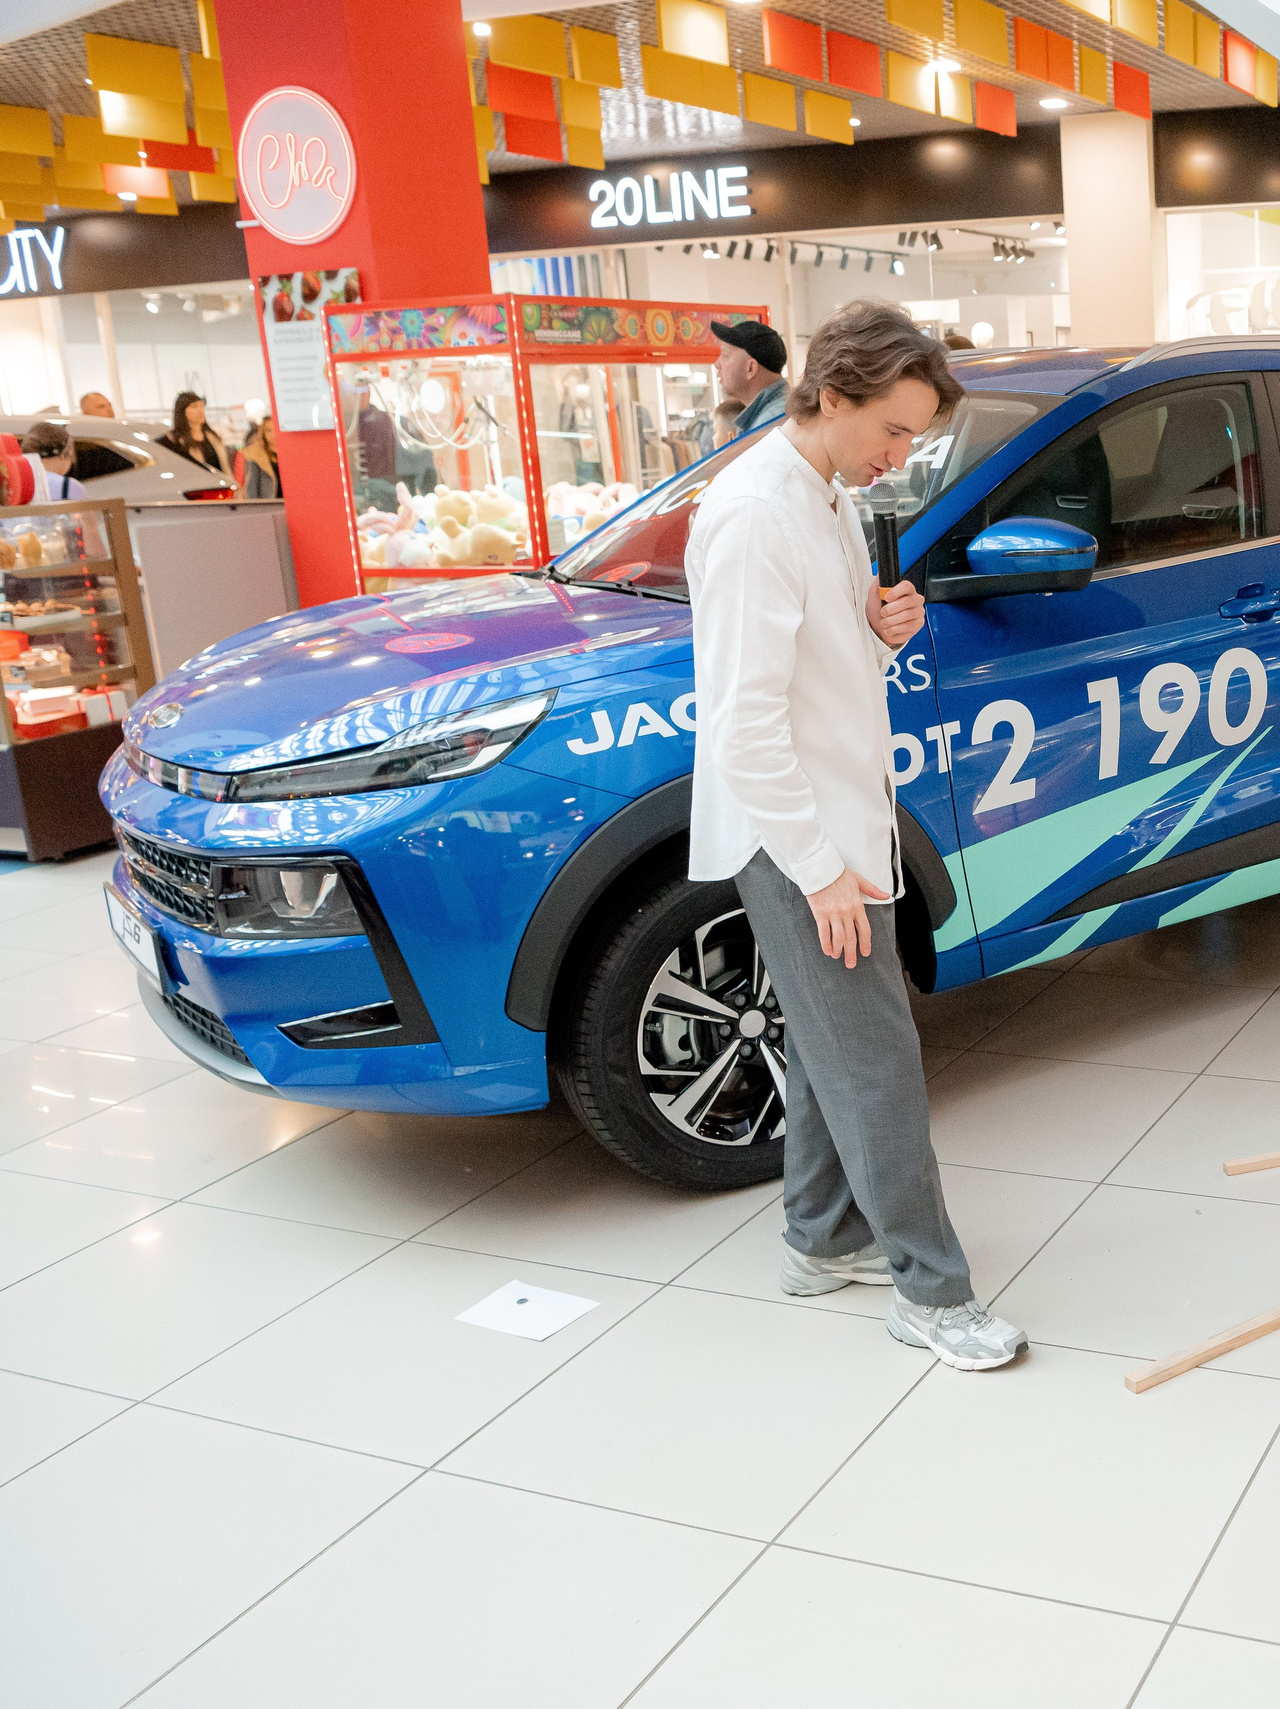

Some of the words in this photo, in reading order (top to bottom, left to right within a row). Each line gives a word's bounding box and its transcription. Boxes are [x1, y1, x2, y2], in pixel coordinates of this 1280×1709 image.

[589, 166, 751, 228] 20LINE
[971, 699, 1037, 816] 2
[1086, 647, 1268, 781] 190
